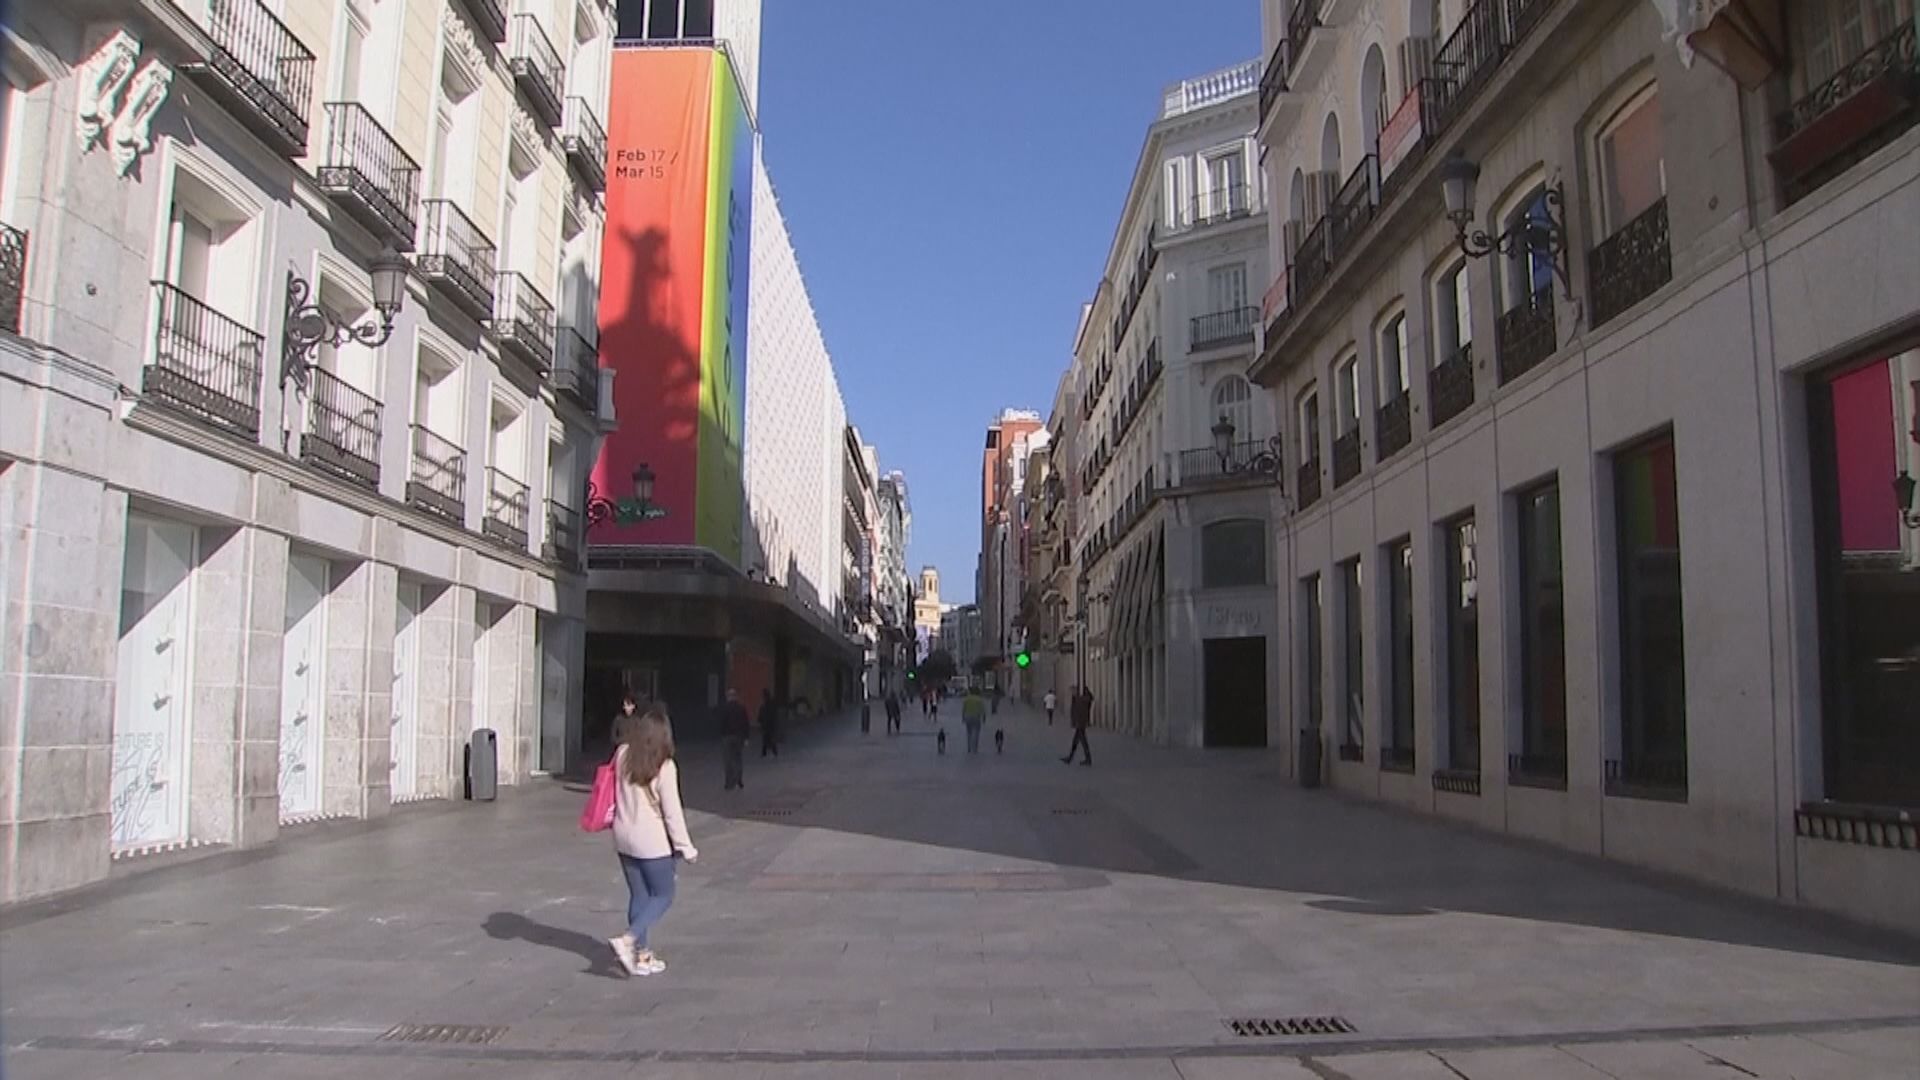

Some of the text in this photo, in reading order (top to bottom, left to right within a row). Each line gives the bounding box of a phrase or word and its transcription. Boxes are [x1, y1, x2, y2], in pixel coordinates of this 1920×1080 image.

[616, 148, 679, 166] Feb 17 /
[615, 165, 664, 179] Mar 15
